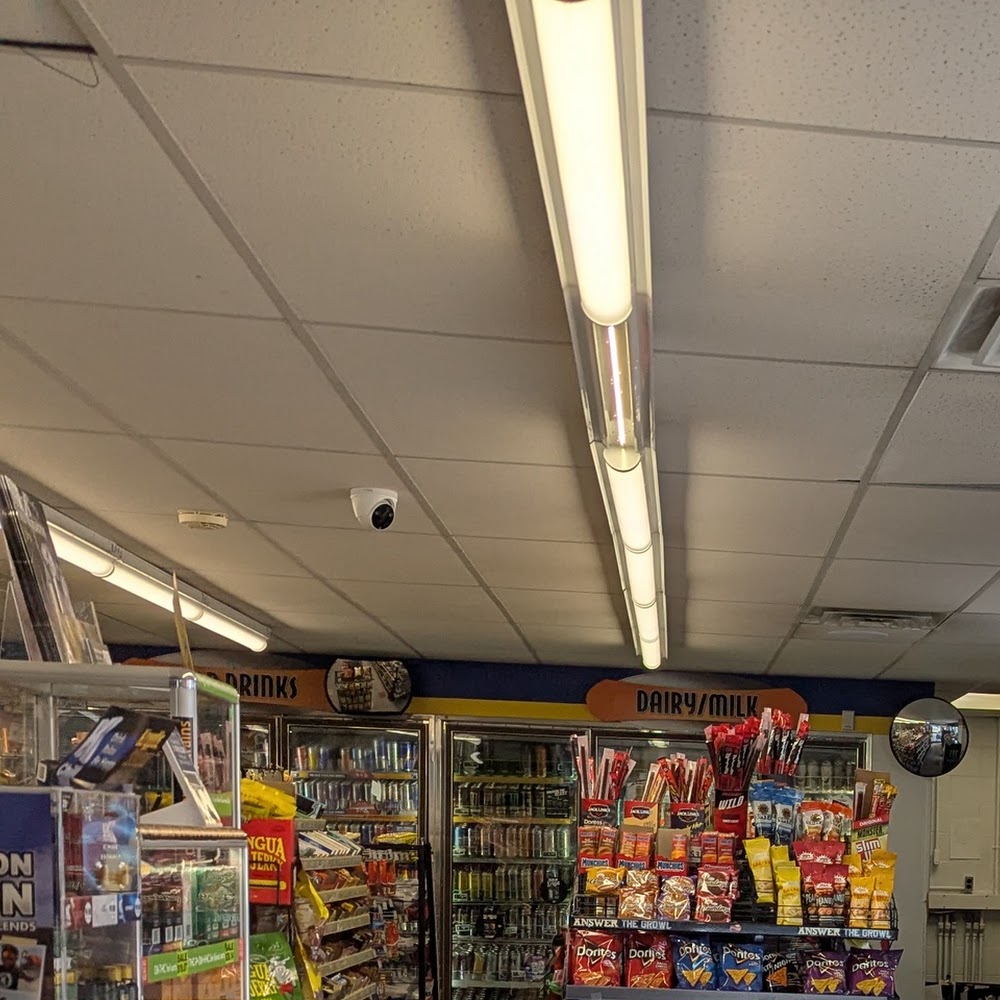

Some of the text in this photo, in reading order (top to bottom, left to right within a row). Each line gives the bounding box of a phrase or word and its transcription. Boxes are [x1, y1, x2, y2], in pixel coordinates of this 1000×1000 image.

[636, 689, 758, 717] DAIRY/MILK
[718, 796, 743, 810] WILD
[247, 836, 287, 862] NGUA
[573, 918, 671, 930] ANSWER THE GROWL
[798, 927, 891, 938] ANSWER THE GROWL
[577, 945, 616, 959] Doritos
[629, 949, 666, 960] Doritos
[806, 959, 844, 969] Doritos
[852, 959, 888, 972] Doritos
